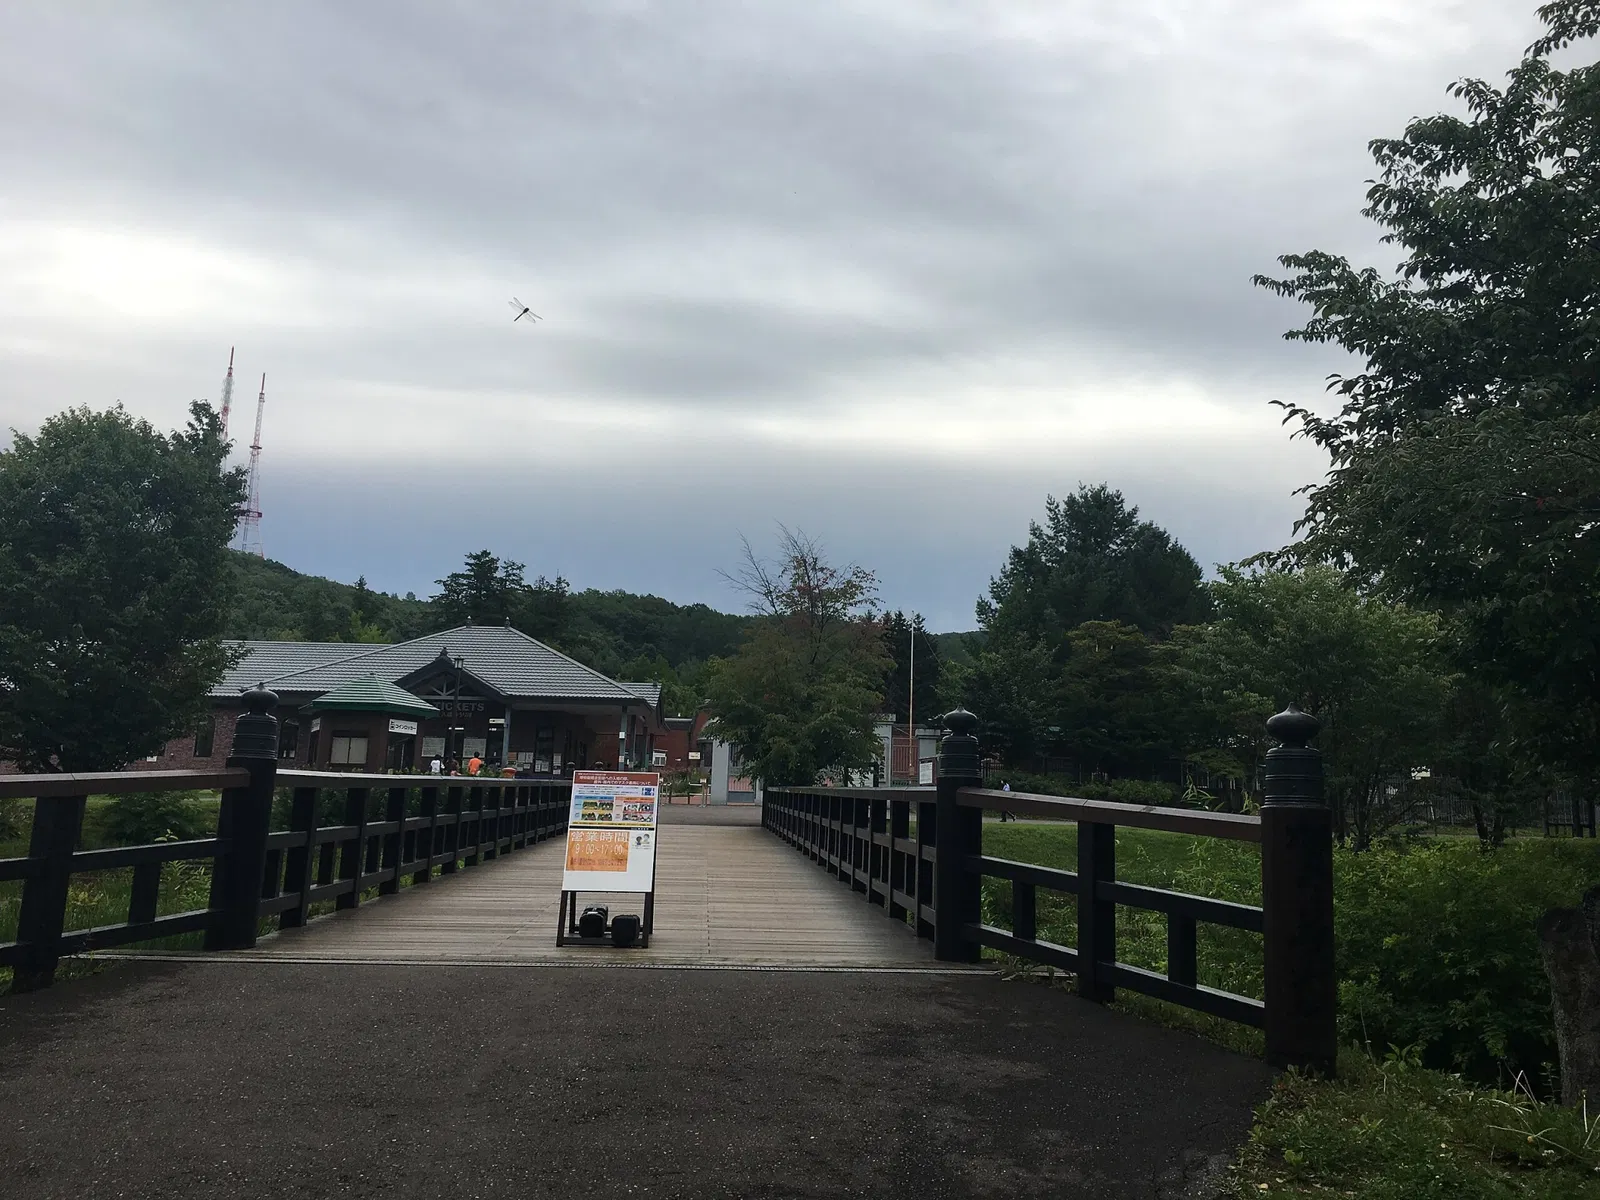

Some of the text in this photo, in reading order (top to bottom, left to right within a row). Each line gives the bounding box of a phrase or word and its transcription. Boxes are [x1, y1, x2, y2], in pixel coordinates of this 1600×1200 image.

[432, 701, 485, 712] TICKETS
[571, 831, 629, 843] 営業時間
